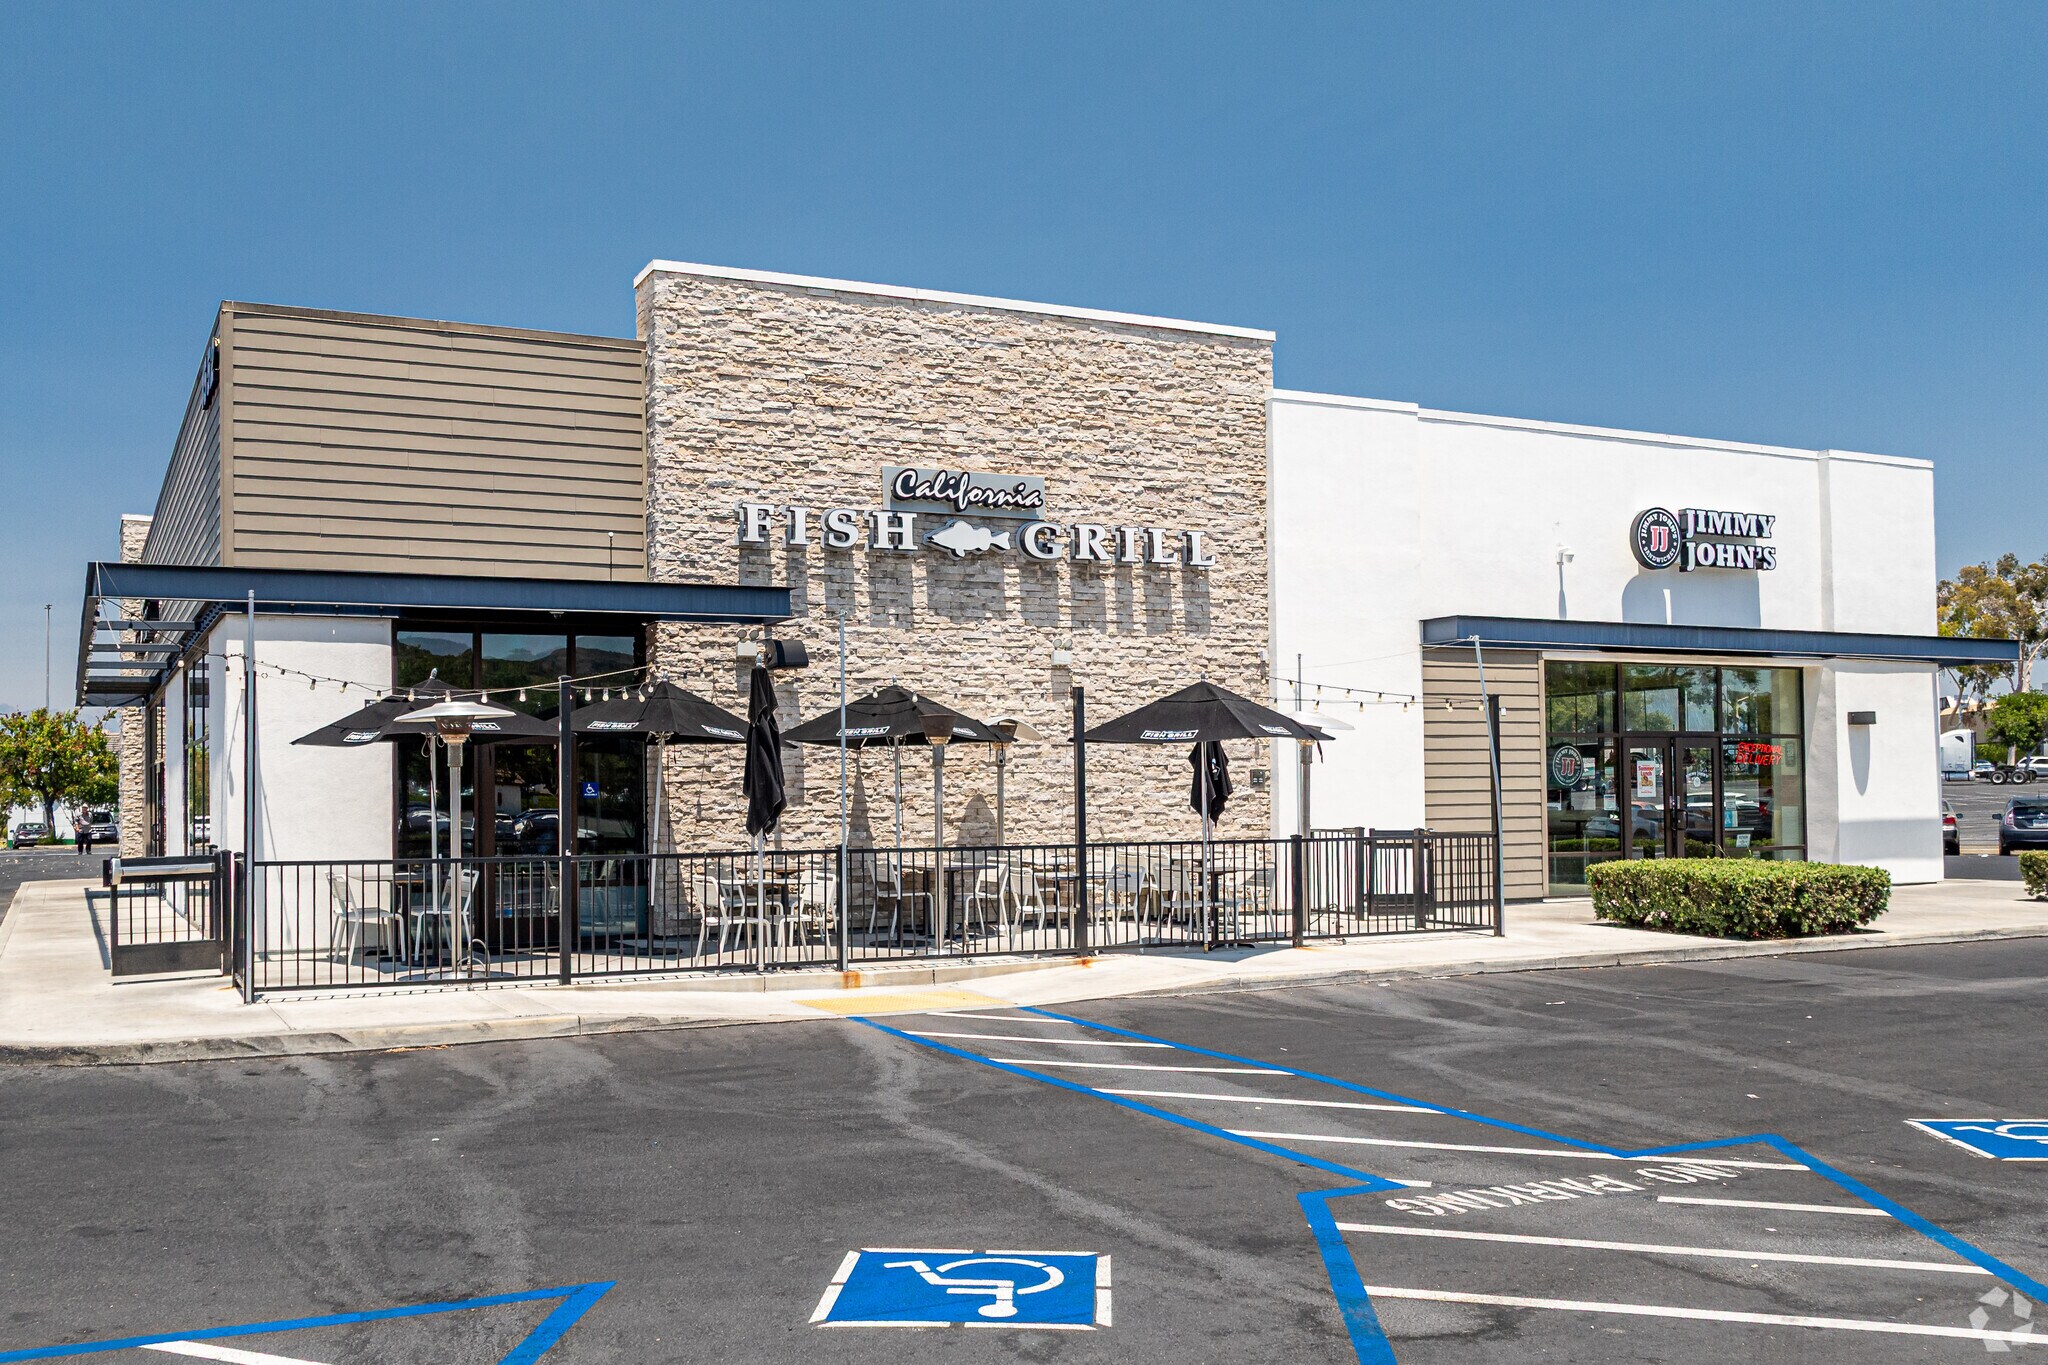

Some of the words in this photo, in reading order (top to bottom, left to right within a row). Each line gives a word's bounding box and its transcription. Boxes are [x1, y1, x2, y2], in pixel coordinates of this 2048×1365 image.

[891, 468, 1044, 512] California
[738, 501, 918, 551] FISH
[1018, 521, 1216, 566] GRILL
[1641, 513, 1658, 538] JIMMY
[1684, 508, 1776, 538] JIMMY
[1650, 525, 1669, 552] JJ
[1684, 541, 1776, 572] JOHN'S
[1144, 731, 1166, 739] FISH
[1737, 742, 1783, 754] EXCEPTIONAL
[1561, 757, 1575, 777] JJ
[1735, 753, 1782, 766] DELIVERY
[1385, 1173, 1646, 1217] PARKING
